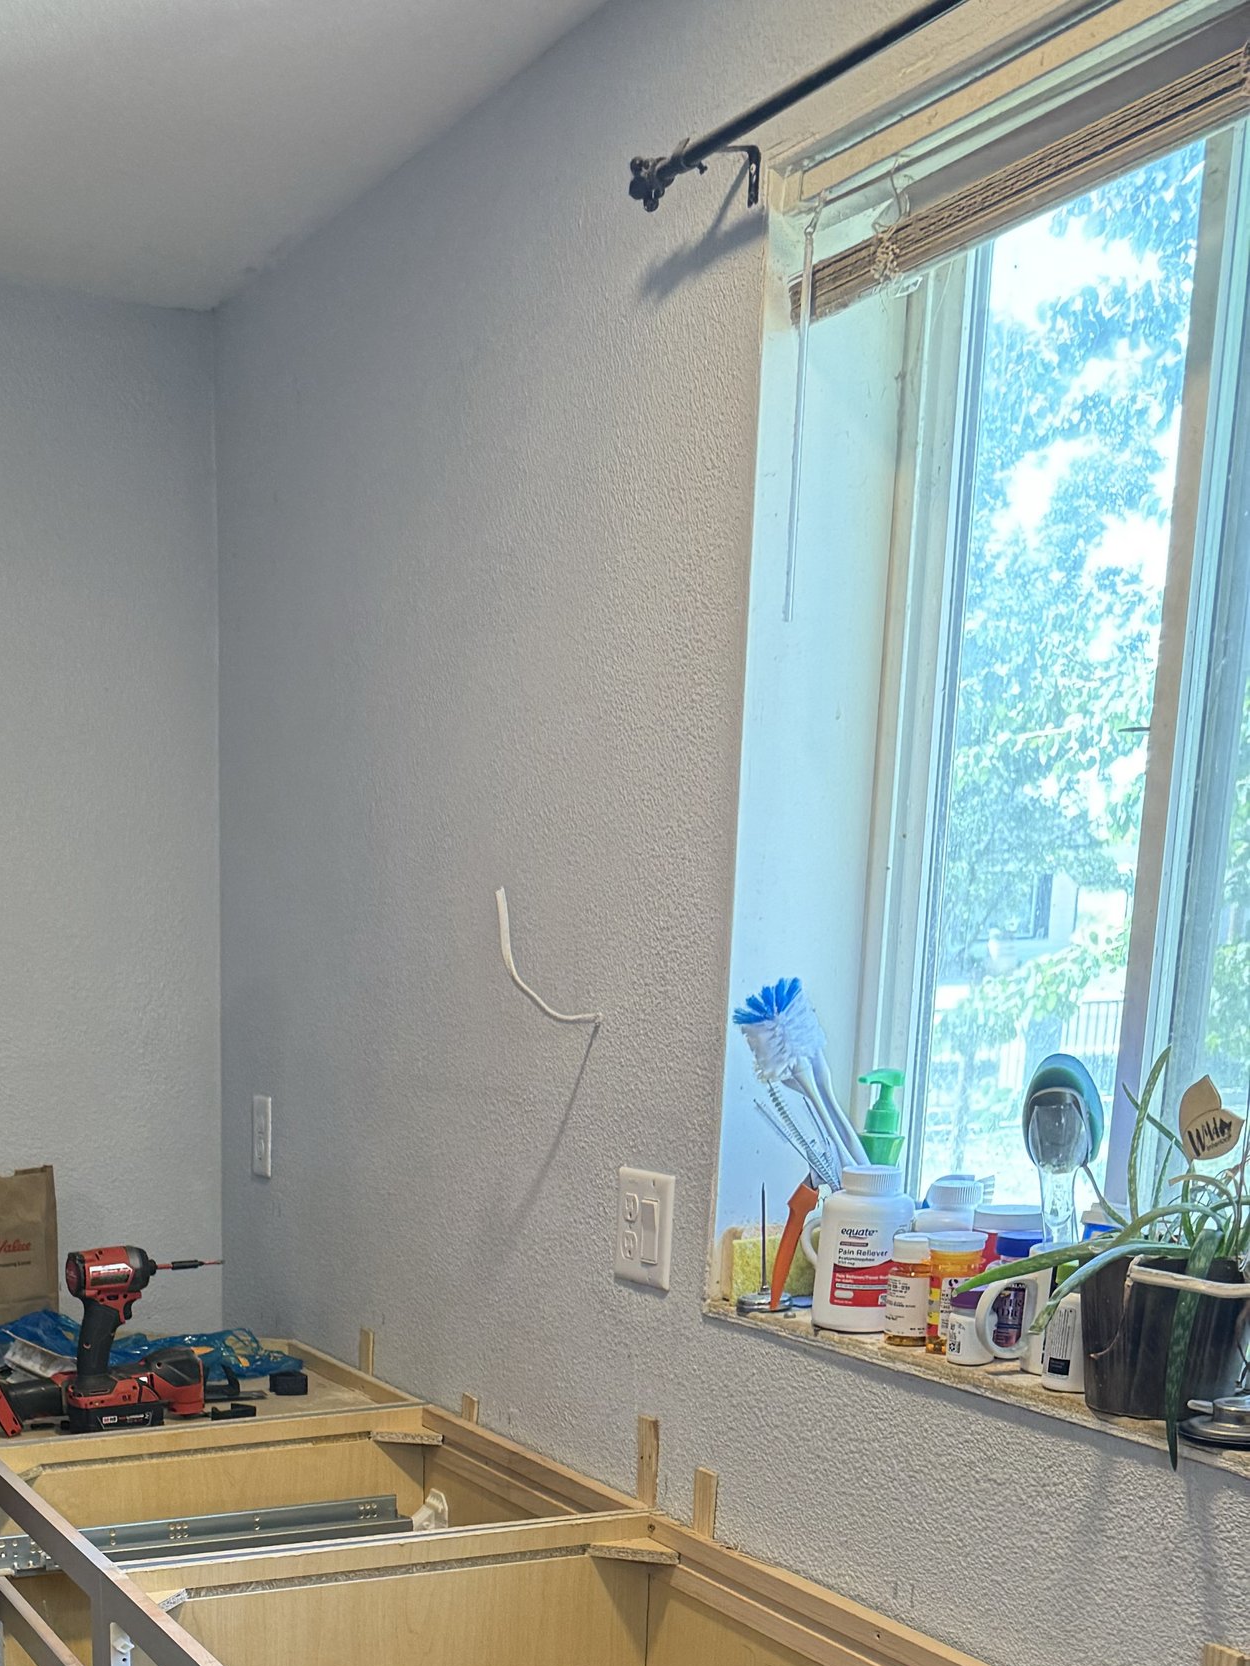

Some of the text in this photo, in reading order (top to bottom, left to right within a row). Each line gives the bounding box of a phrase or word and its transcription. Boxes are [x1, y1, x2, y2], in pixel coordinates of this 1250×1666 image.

[841, 1228, 875, 1238] equate
[838, 1248, 888, 1257] Pain Reliever
